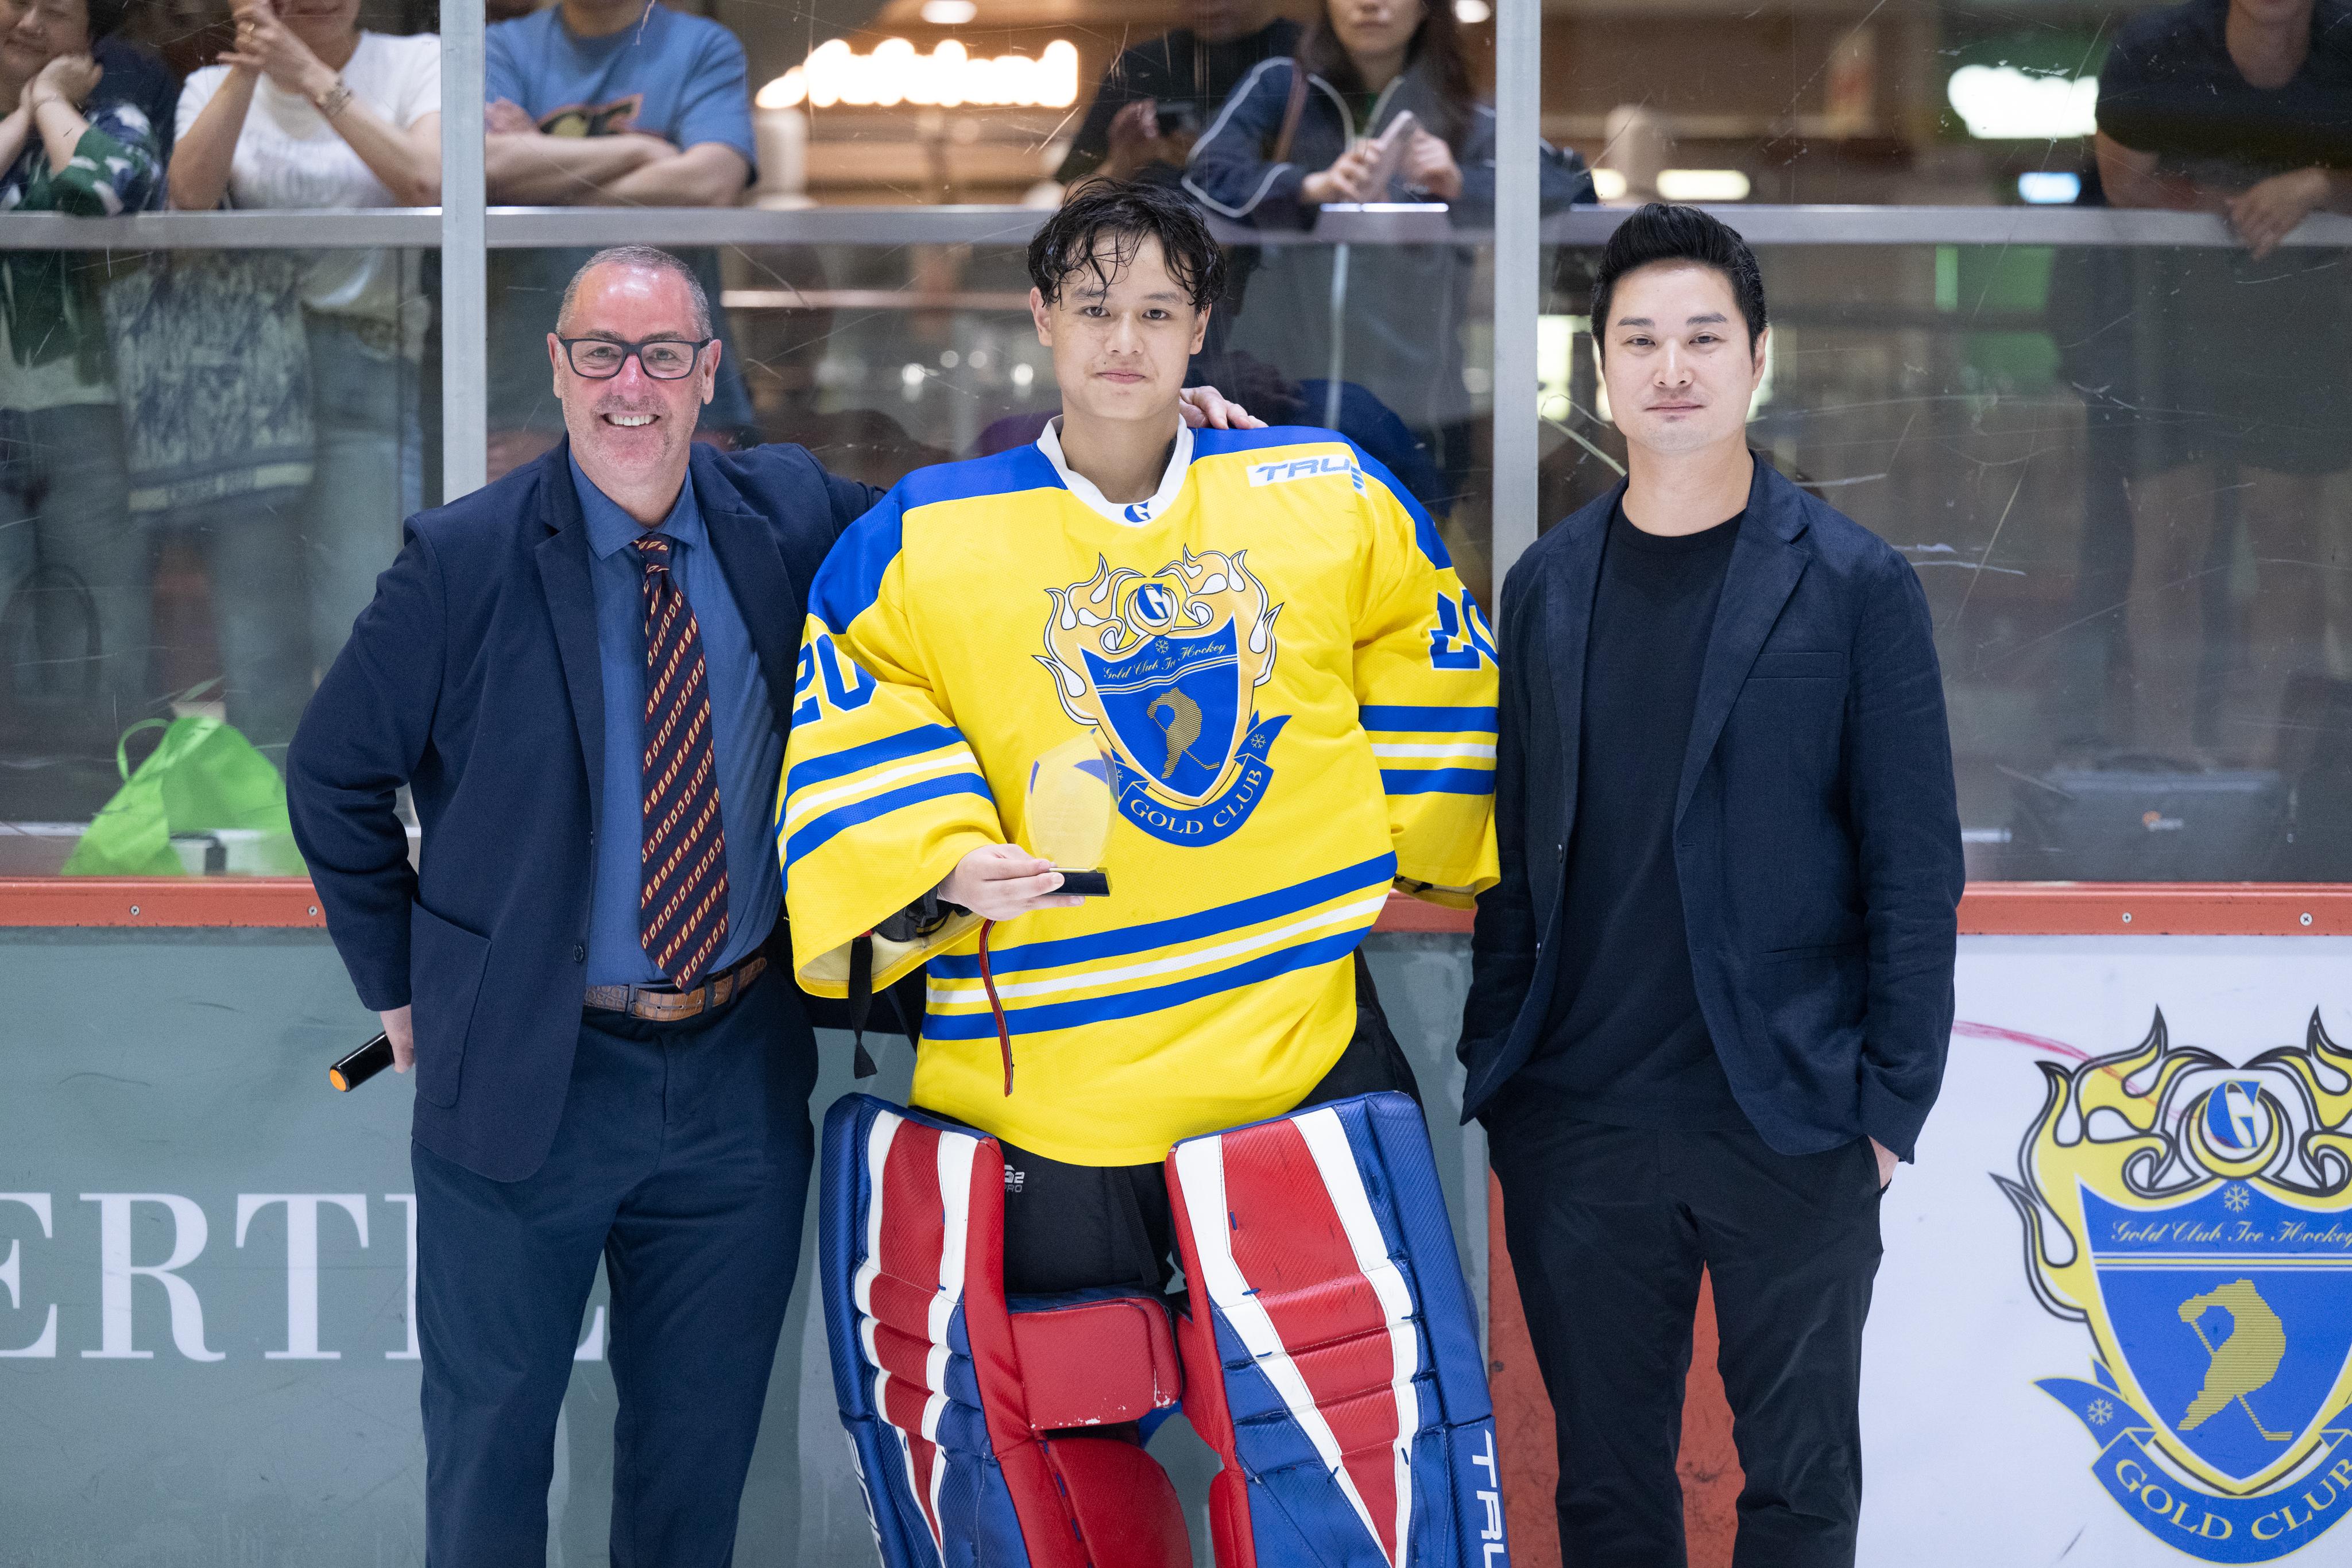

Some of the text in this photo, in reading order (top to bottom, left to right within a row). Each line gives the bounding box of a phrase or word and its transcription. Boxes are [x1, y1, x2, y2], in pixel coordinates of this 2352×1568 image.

[791, 632, 879, 732] 20
[1103, 666, 1132, 679] Gold
[1134, 659, 1159, 675] Club
[1178, 640, 1227, 661] Hockey
[1130, 799, 1204, 834] GOLD
[1213, 769, 1262, 827] CLUB
[1004, 1184, 1023, 1193] RO
[2111, 1221, 2169, 1242] Gold
[2172, 1221, 2225, 1242] Club
[2228, 1221, 2264, 1242] Ice
[2115, 1458, 2352, 1540] GOLD CLUB
